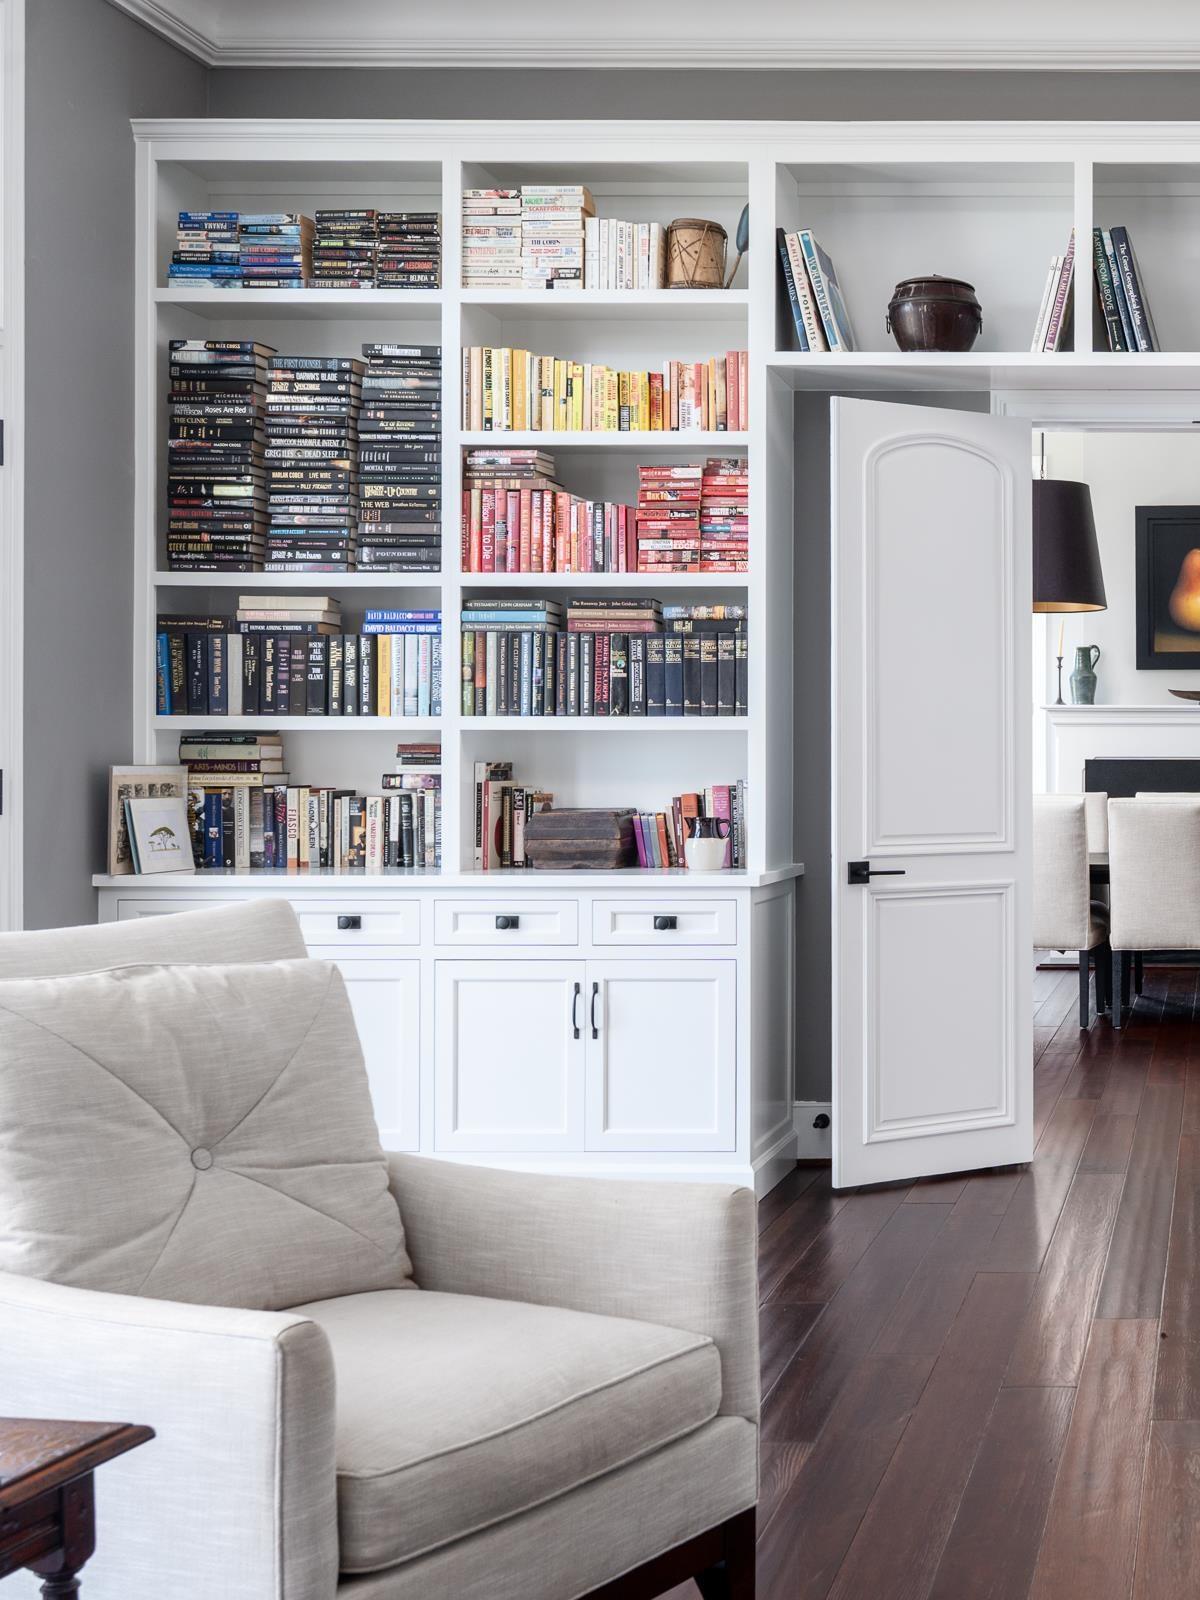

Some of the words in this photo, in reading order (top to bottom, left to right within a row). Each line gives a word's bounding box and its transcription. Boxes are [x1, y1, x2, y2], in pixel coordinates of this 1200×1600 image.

[1093, 232, 1104, 256] EARTH
[808, 257, 823, 290] WORLD
[1097, 258, 1108, 281] FROM
[789, 237, 800, 268] VANITY
[797, 270, 805, 289] FAIR
[801, 294, 816, 340] PORTRAITS
[1058, 271, 1070, 301] WORLD
[1102, 284, 1114, 310] ABOVE
[1126, 272, 1140, 309] Geographical
[1048, 304, 1064, 338] HISTORY
[273, 360, 282, 368] THE
[284, 360, 298, 368] FIRST
[298, 360, 322, 368] COUNSEL
[321, 373, 338, 381] BLADE
[265, 450, 280, 458] GREG
[282, 450, 293, 458] ILES
[304, 450, 320, 458] DEAD
[322, 450, 338, 458] SLEEP
[168, 543, 186, 551] STEVE
[187, 543, 213, 551] MARTINI
[483, 535, 492, 544] to
[483, 546, 493, 559] Die
[265, 639, 274, 648] Tom
[289, 809, 297, 839] FIASCO
